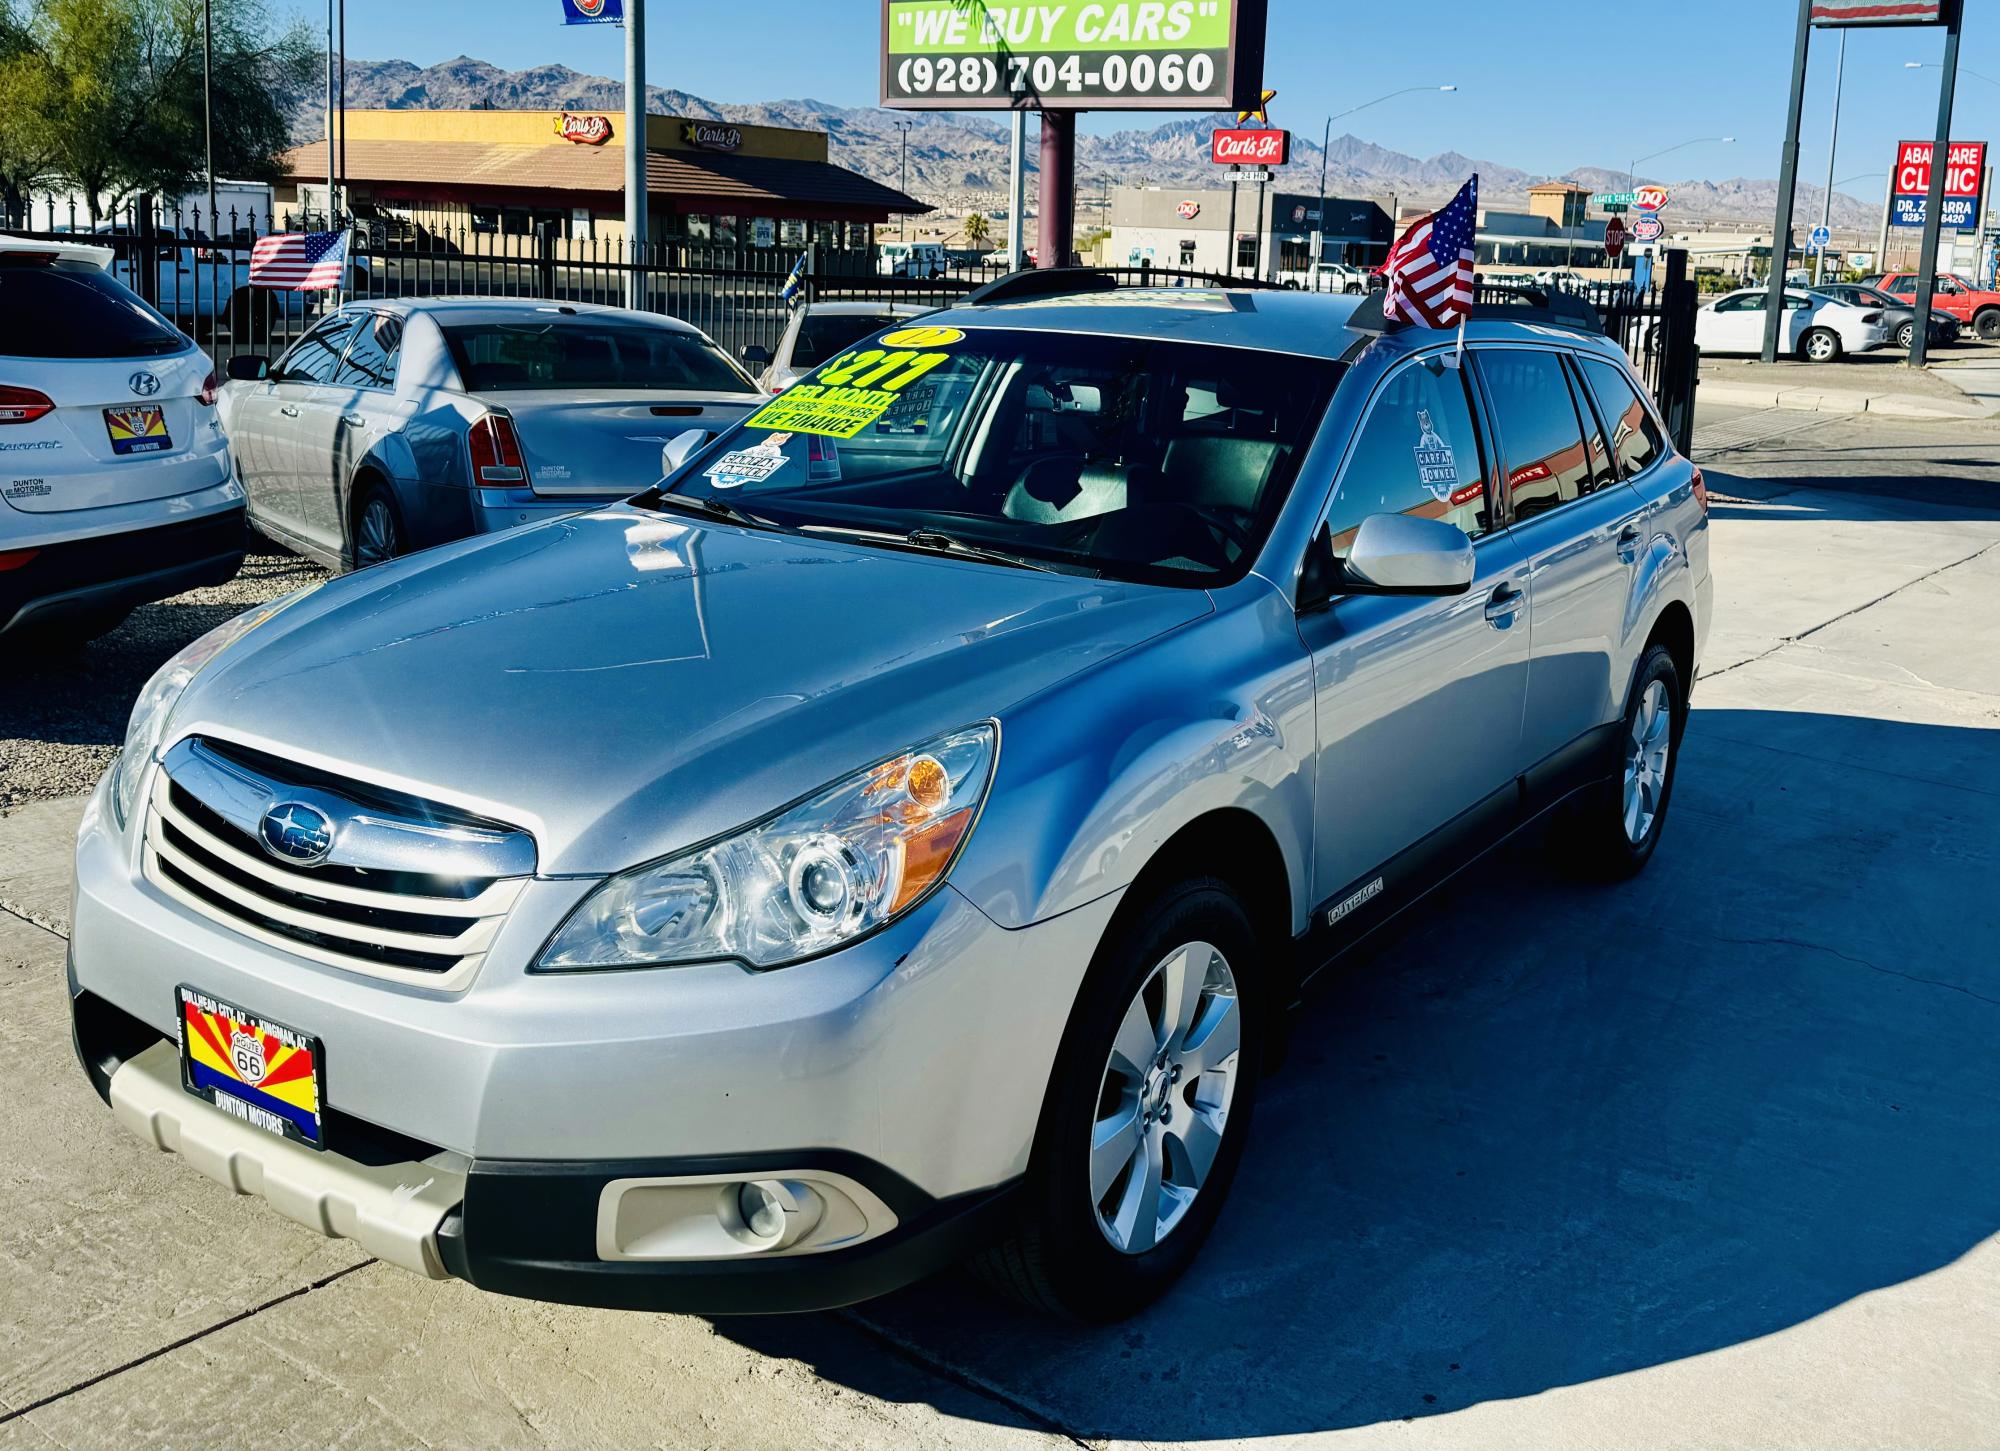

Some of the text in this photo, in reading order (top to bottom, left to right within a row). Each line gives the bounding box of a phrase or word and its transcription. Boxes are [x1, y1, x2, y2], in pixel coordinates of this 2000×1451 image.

[978, 5, 1062, 43] BUY
[1074, 1, 1218, 42] CARS"
[897, 53, 1215, 93] (928) 704-0060
[1217, 134, 1279, 157] Carl's Jr.
[1594, 194, 1612, 203] AGATE
[1637, 191, 1663, 206] DQ
[1897, 200, 1917, 213] DR.
[1902, 212, 1965, 224] 928-76420
[1606, 230, 1624, 245] STOP
[820, 386, 901, 408] MONTH
[134, 423, 145, 432] 66
[753, 410, 863, 434] WE FINANCE
[1418, 452, 1453, 466] CARFAX
[13, 478, 44, 487] DUNTON
[13, 485, 44, 493] MOTORS
[1330, 879, 1381, 923] OUTBACK
[181, 987, 217, 1015] BULLHEAD
[236, 1011, 247, 1026] AZ
[296, 1034, 307, 1051] AZ
[236, 1037, 260, 1053] ROUTE
[237, 1051, 260, 1077] 66
[215, 1090, 284, 1136] DUNTON MOTORS
